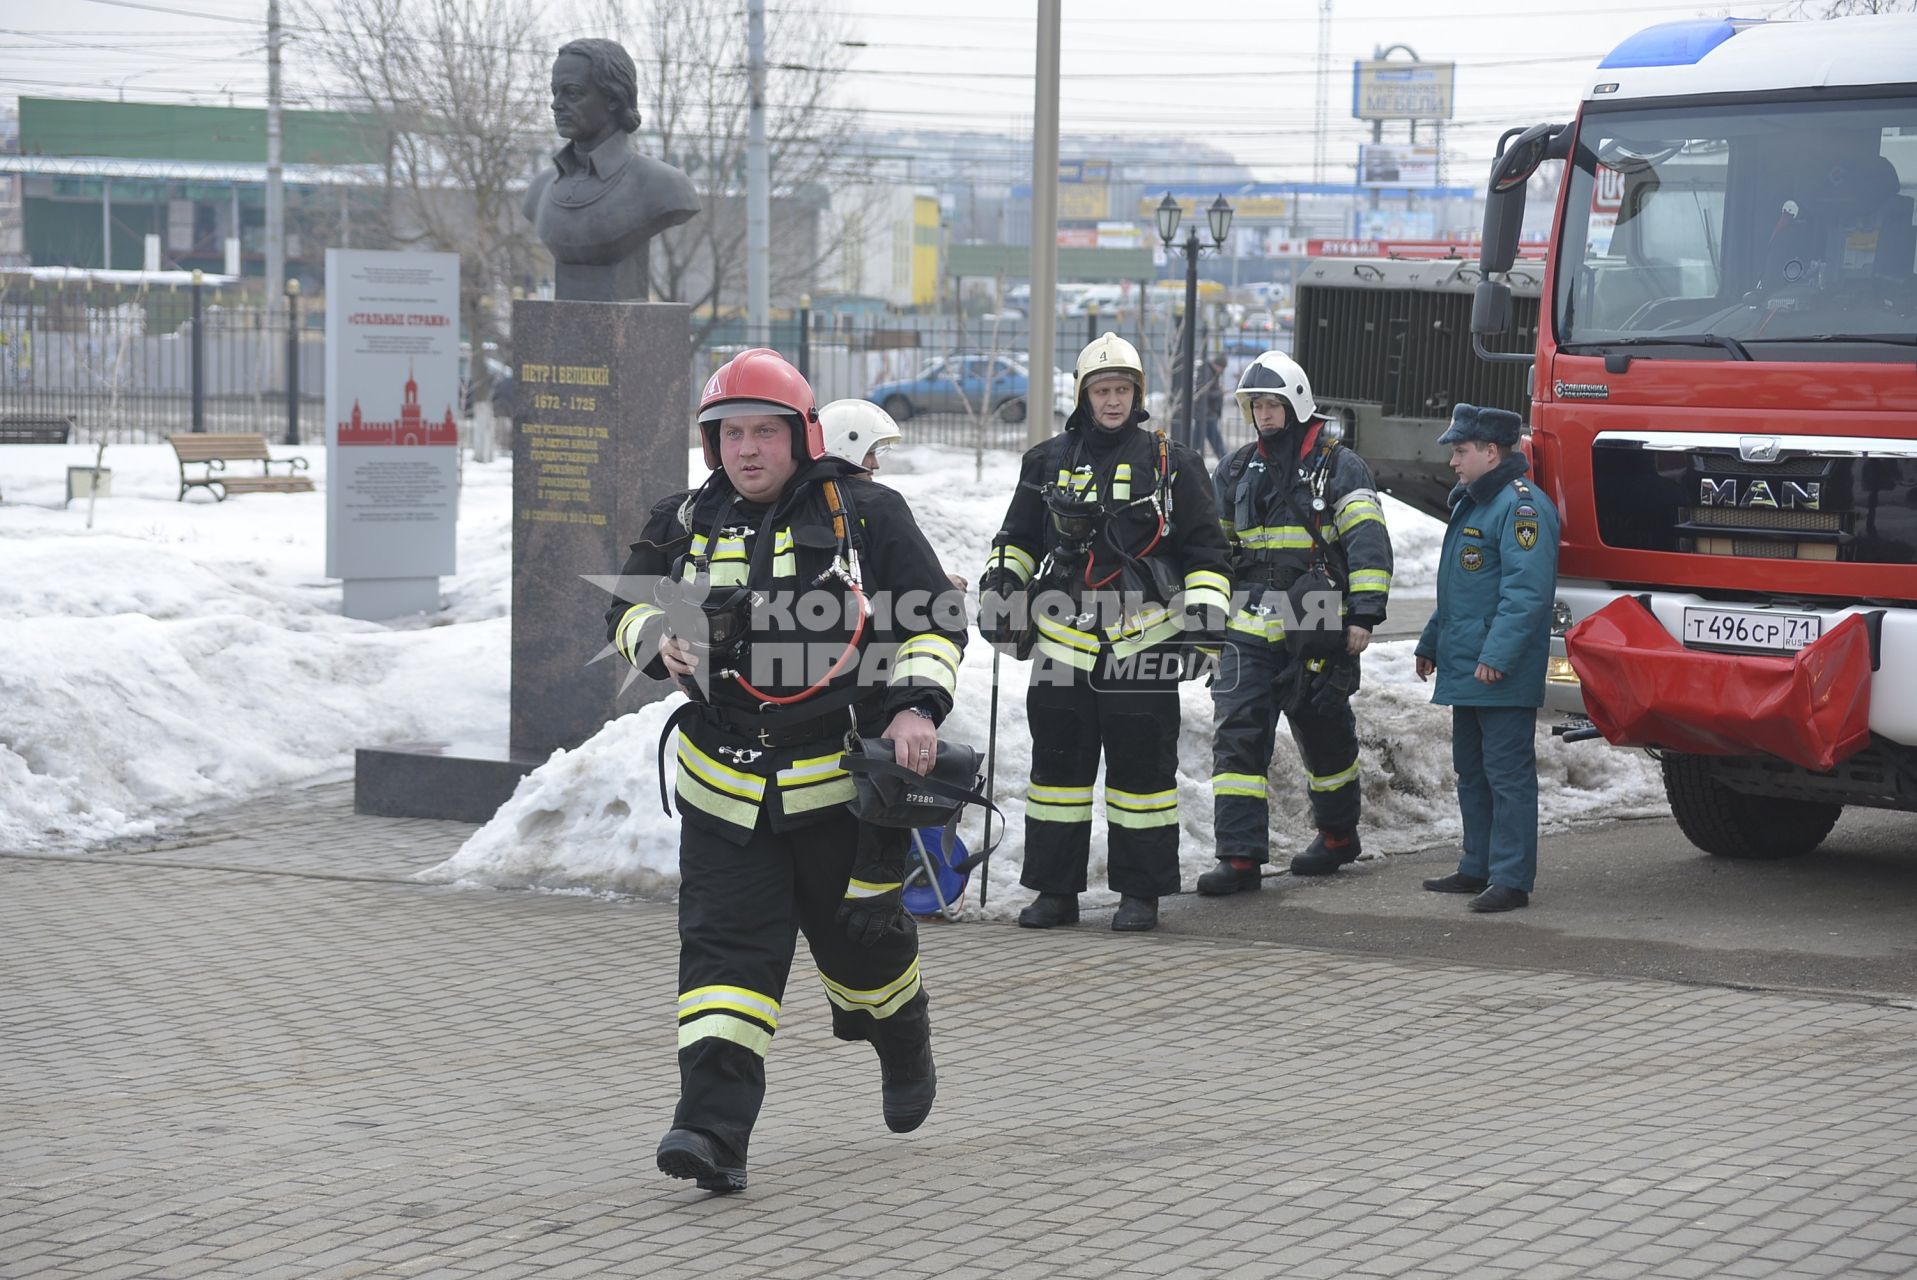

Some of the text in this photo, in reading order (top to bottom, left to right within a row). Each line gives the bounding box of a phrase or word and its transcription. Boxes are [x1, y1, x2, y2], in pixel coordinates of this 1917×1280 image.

[522, 364, 549, 383] ПЕТР
[559, 364, 609, 386] ВЕЛИКИЙ
[535, 395, 560, 410] 1672
[570, 396, 596, 412] 1725
[1701, 478, 1820, 511] MAN
[1787, 619, 1810, 640] 71
[1785, 638, 1803, 647] RUS
